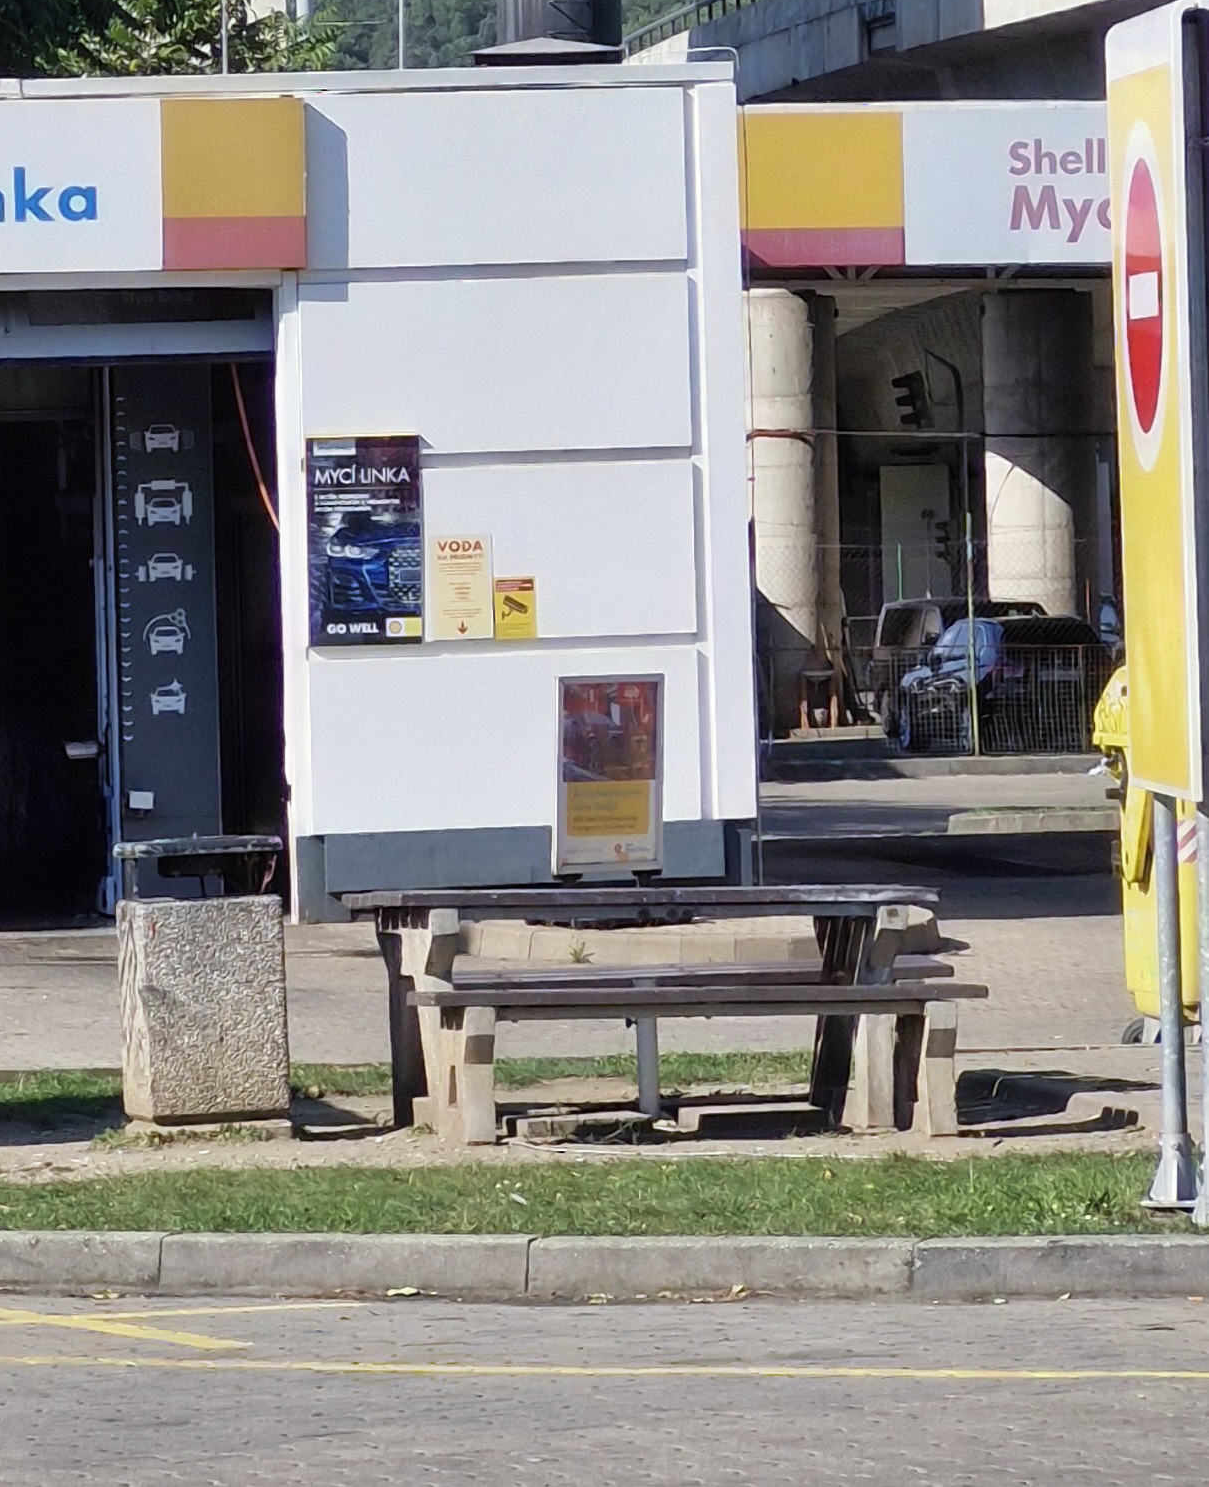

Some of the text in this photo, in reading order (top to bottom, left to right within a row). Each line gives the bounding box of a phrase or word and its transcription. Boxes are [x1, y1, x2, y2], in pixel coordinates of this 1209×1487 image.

[1008, 137, 1106, 176] Shell
[360, 467, 411, 484] LINKA
[437, 540, 483, 552] VODA
[326, 621, 380, 635] GO WELL
